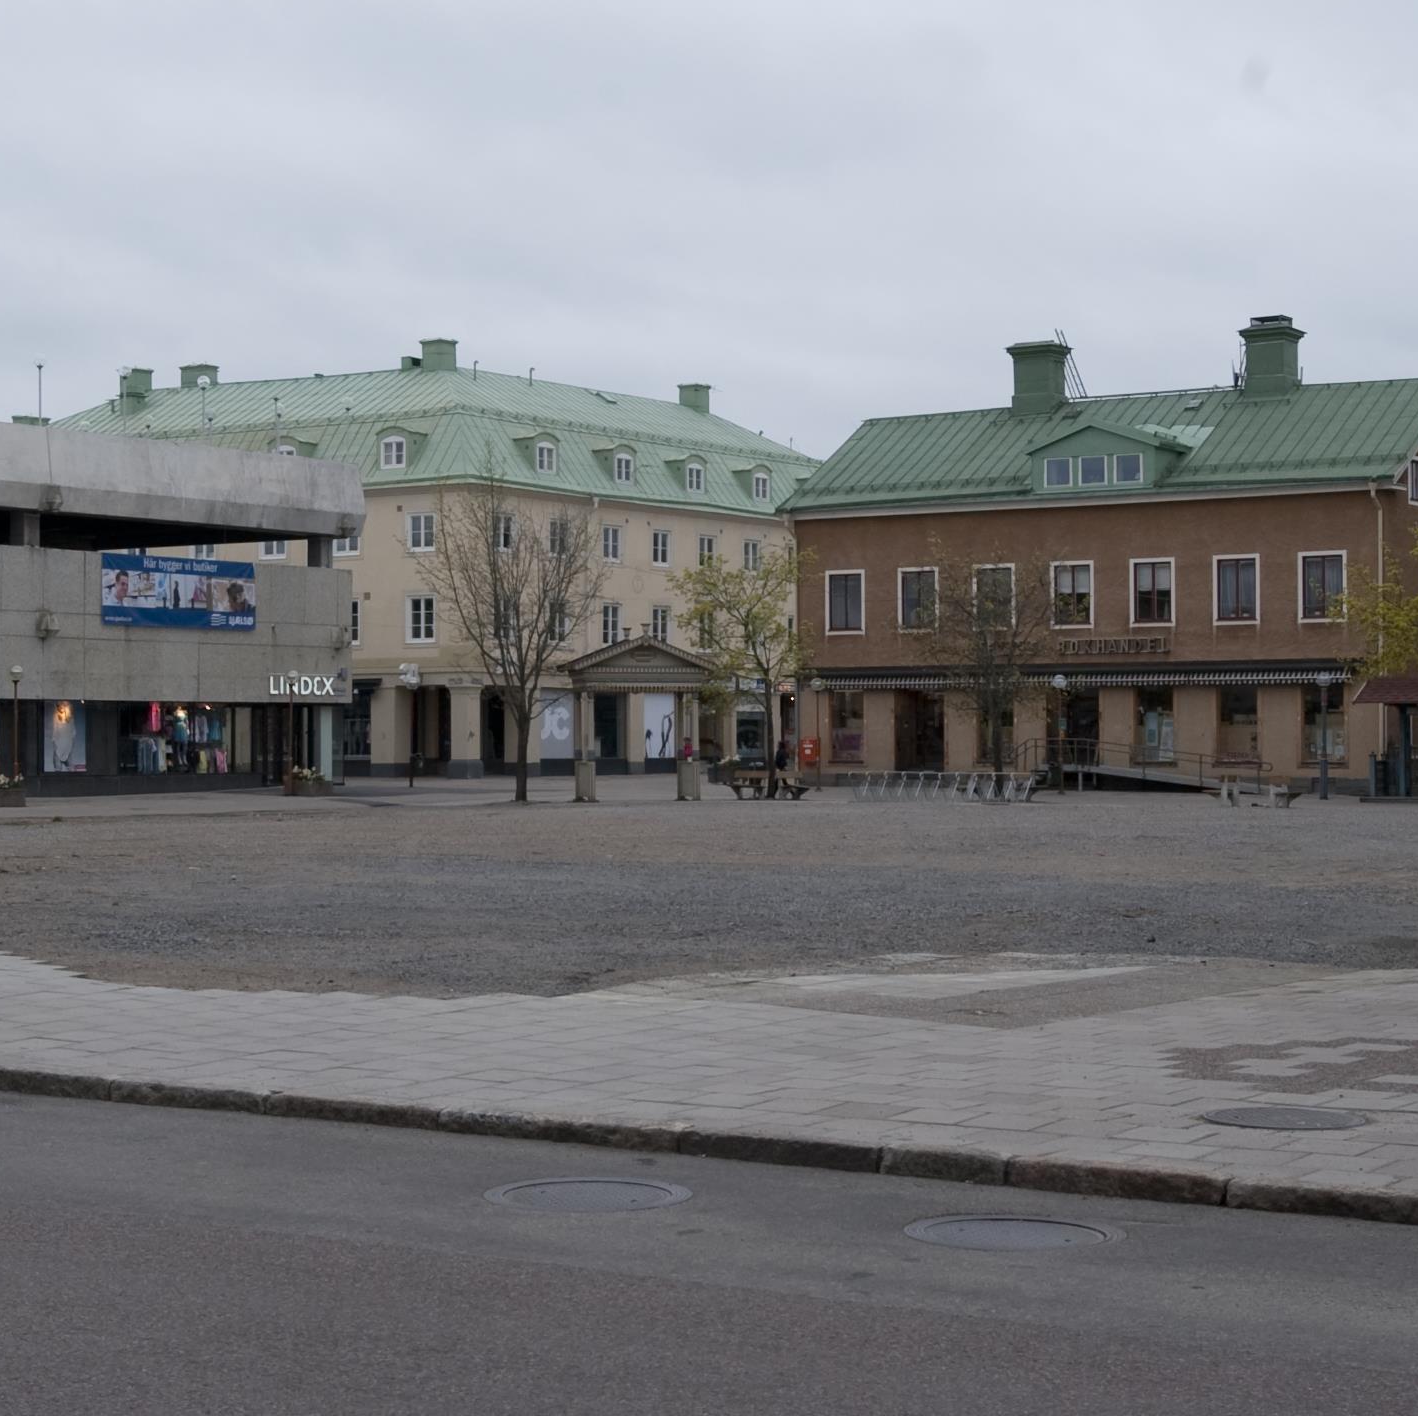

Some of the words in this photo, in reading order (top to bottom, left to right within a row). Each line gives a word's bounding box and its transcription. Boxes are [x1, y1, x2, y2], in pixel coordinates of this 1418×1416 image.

[143, 557, 157, 568] Här
[158, 560, 183, 572] bygger
[184, 562, 191, 571] vi
[193, 562, 218, 573] butiker
[269, 675, 334, 696] LINDEX
